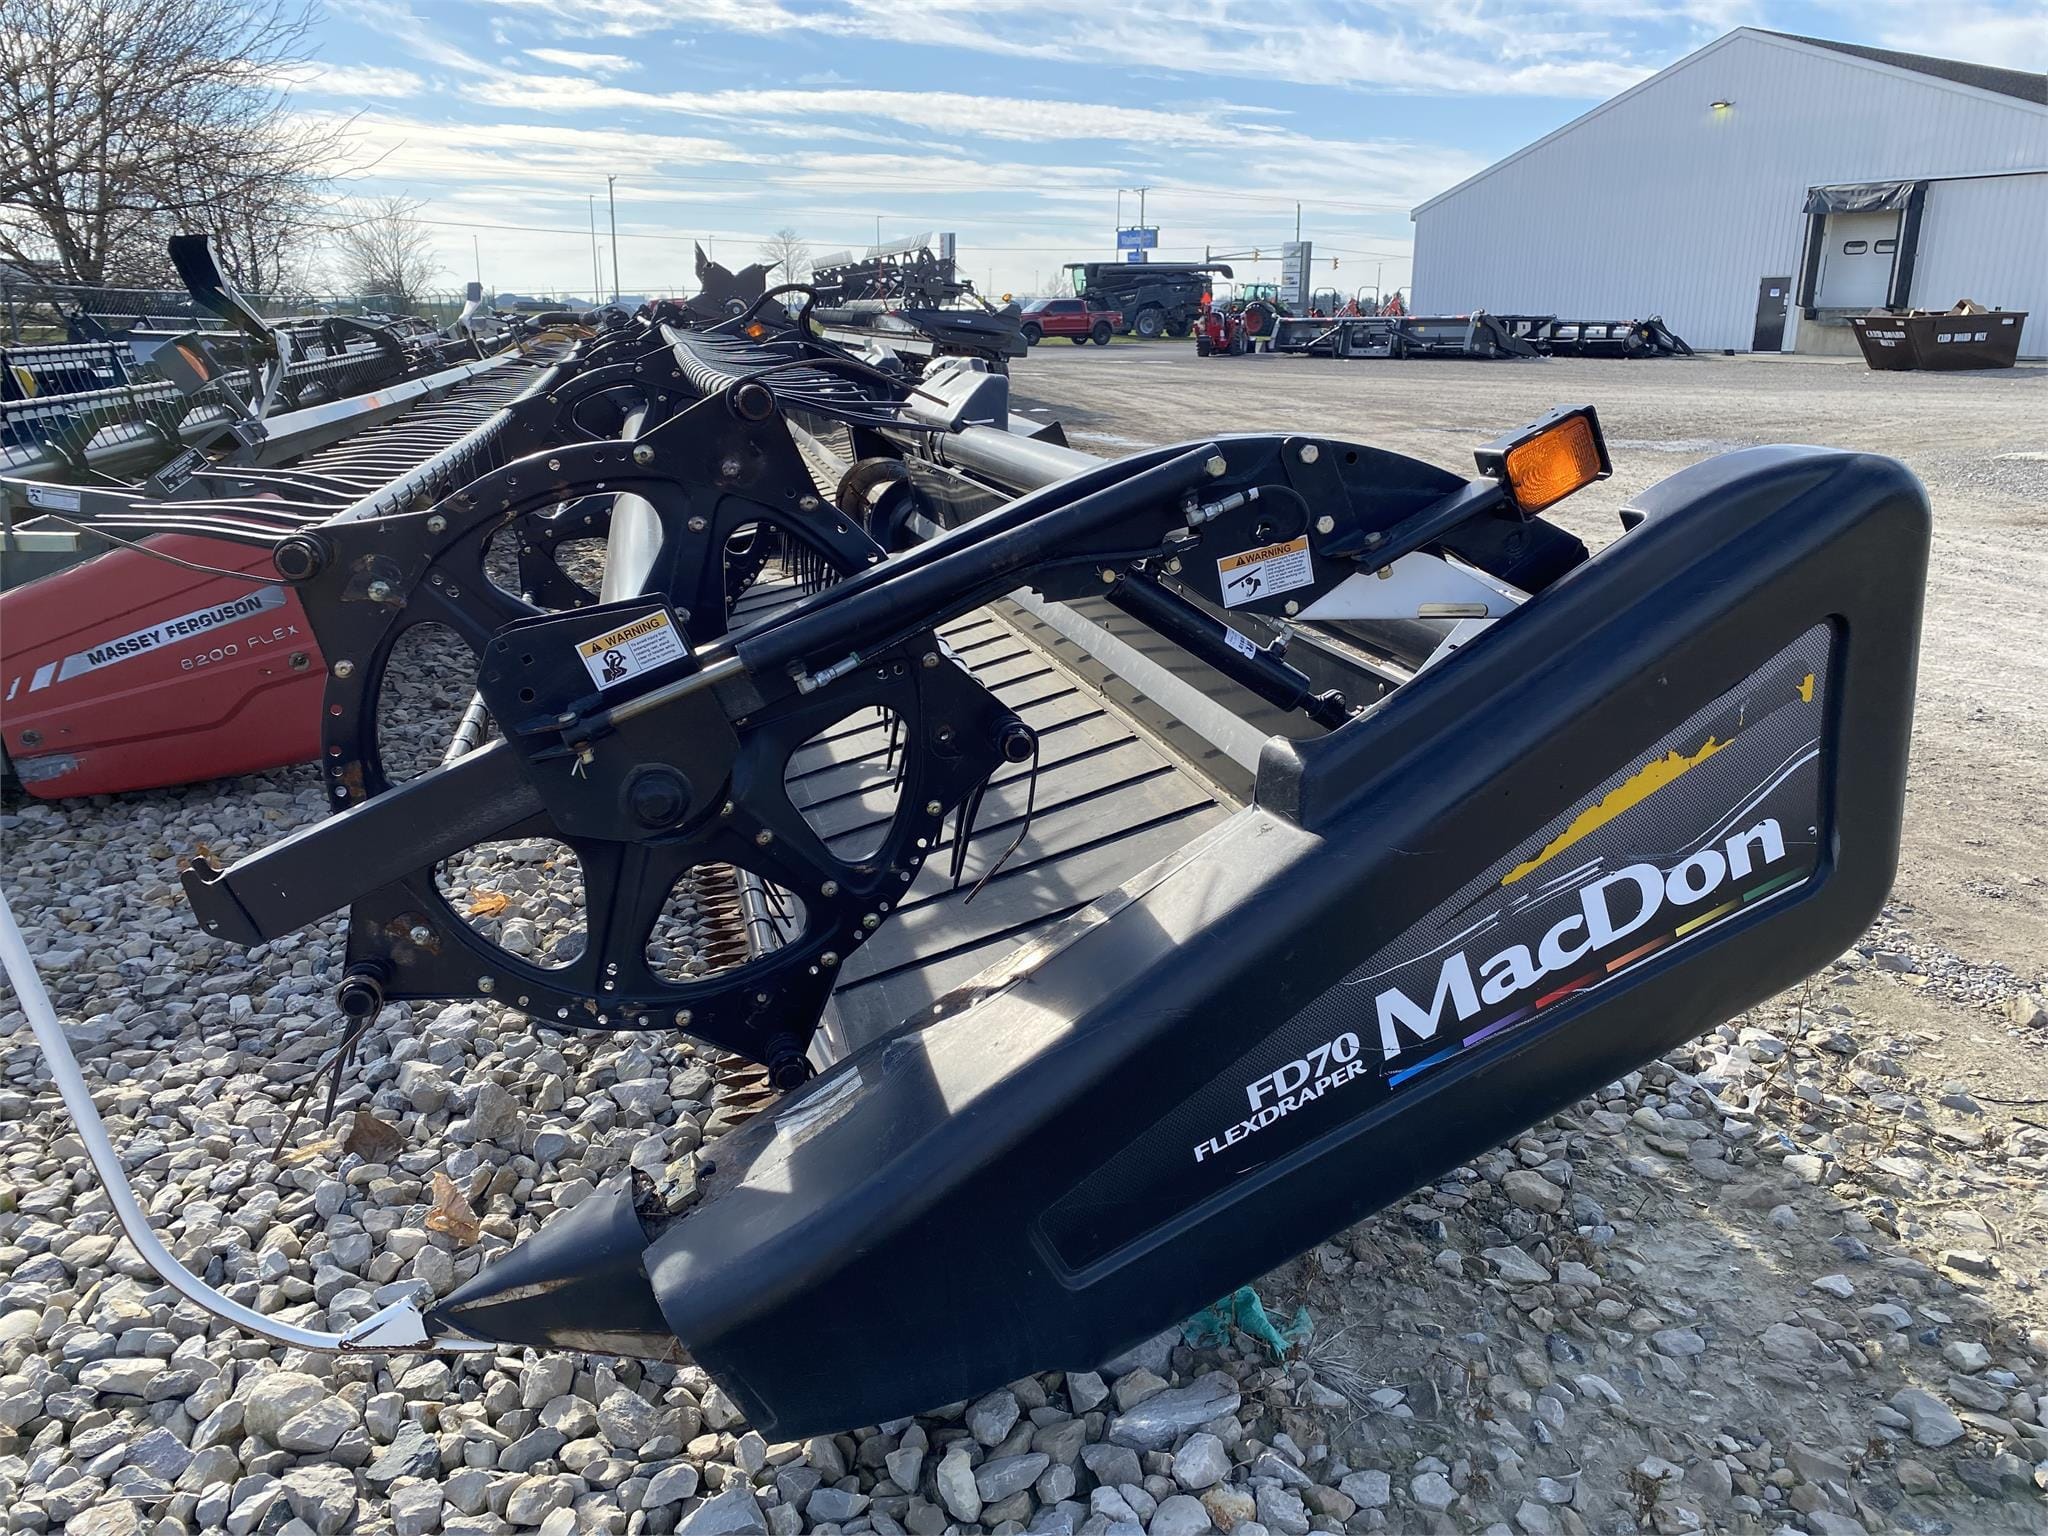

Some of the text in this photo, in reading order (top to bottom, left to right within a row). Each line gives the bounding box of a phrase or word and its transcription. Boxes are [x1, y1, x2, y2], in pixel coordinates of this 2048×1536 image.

[1245, 544, 1291, 563] WARNING
[87, 596, 263, 666] MASSEY FERGUSON
[180, 644, 239, 671] 8200
[605, 618, 661, 647] WARNING
[1374, 818, 1785, 1061] MacDon
[1246, 1032, 1361, 1112] FD70
[1193, 1059, 1367, 1163] FLEXDRAPER
